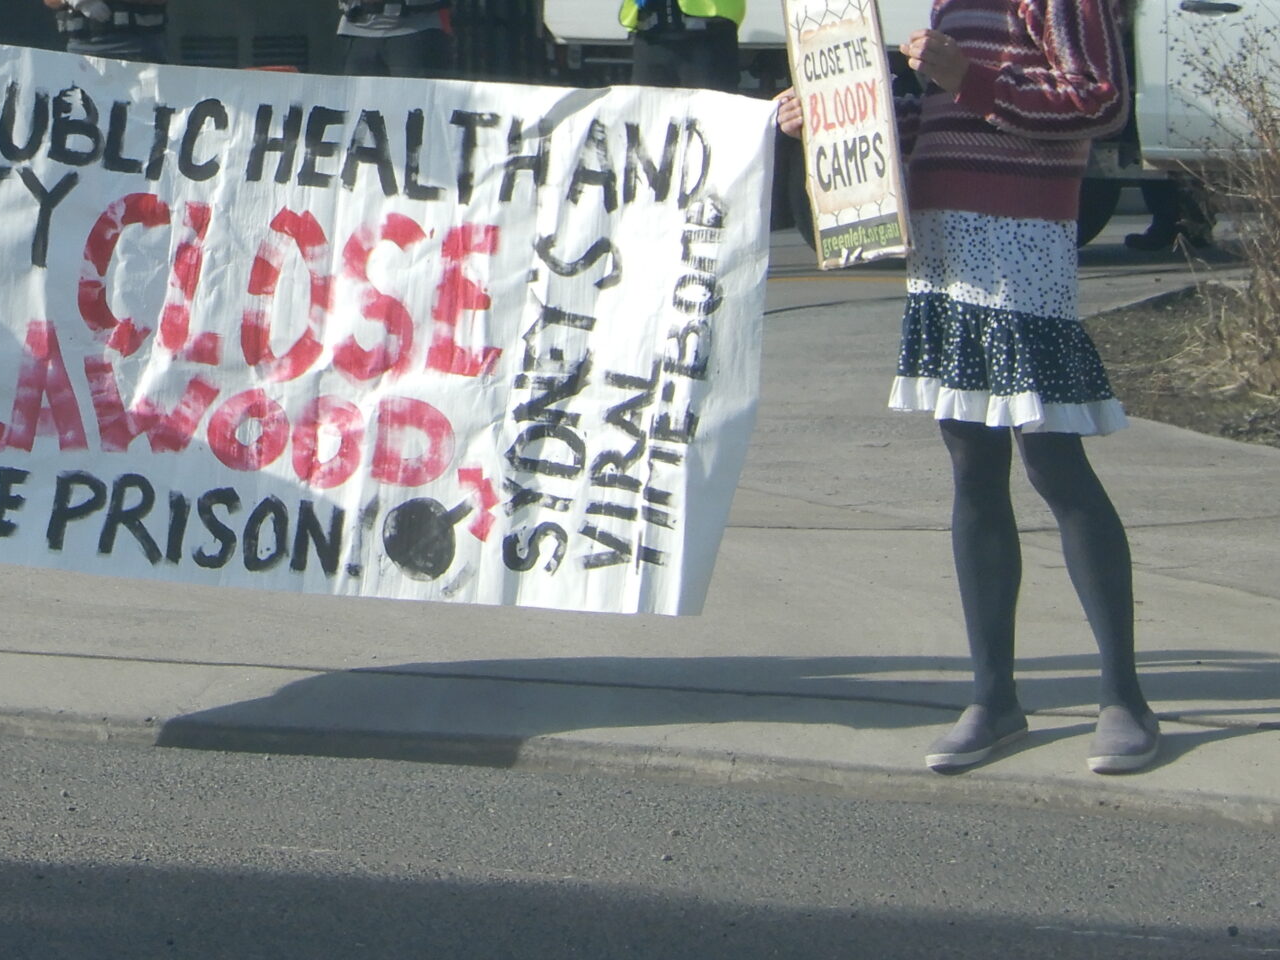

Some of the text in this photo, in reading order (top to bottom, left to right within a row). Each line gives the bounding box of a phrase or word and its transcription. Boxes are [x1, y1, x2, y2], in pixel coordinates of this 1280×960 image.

[803, 37, 872, 82] CLOSE THE
[809, 78, 879, 136] BLOODY
[246, 102, 554, 205] HEALTH
[567, 116, 711, 213] AND
[816, 131, 886, 193] CAMPS
[822, 220, 900, 258] greenleft.org.au
[77, 192, 504, 383] CLOSE
[577, 357, 662, 571] VIRAL
[635, 381, 699, 575] TIME
